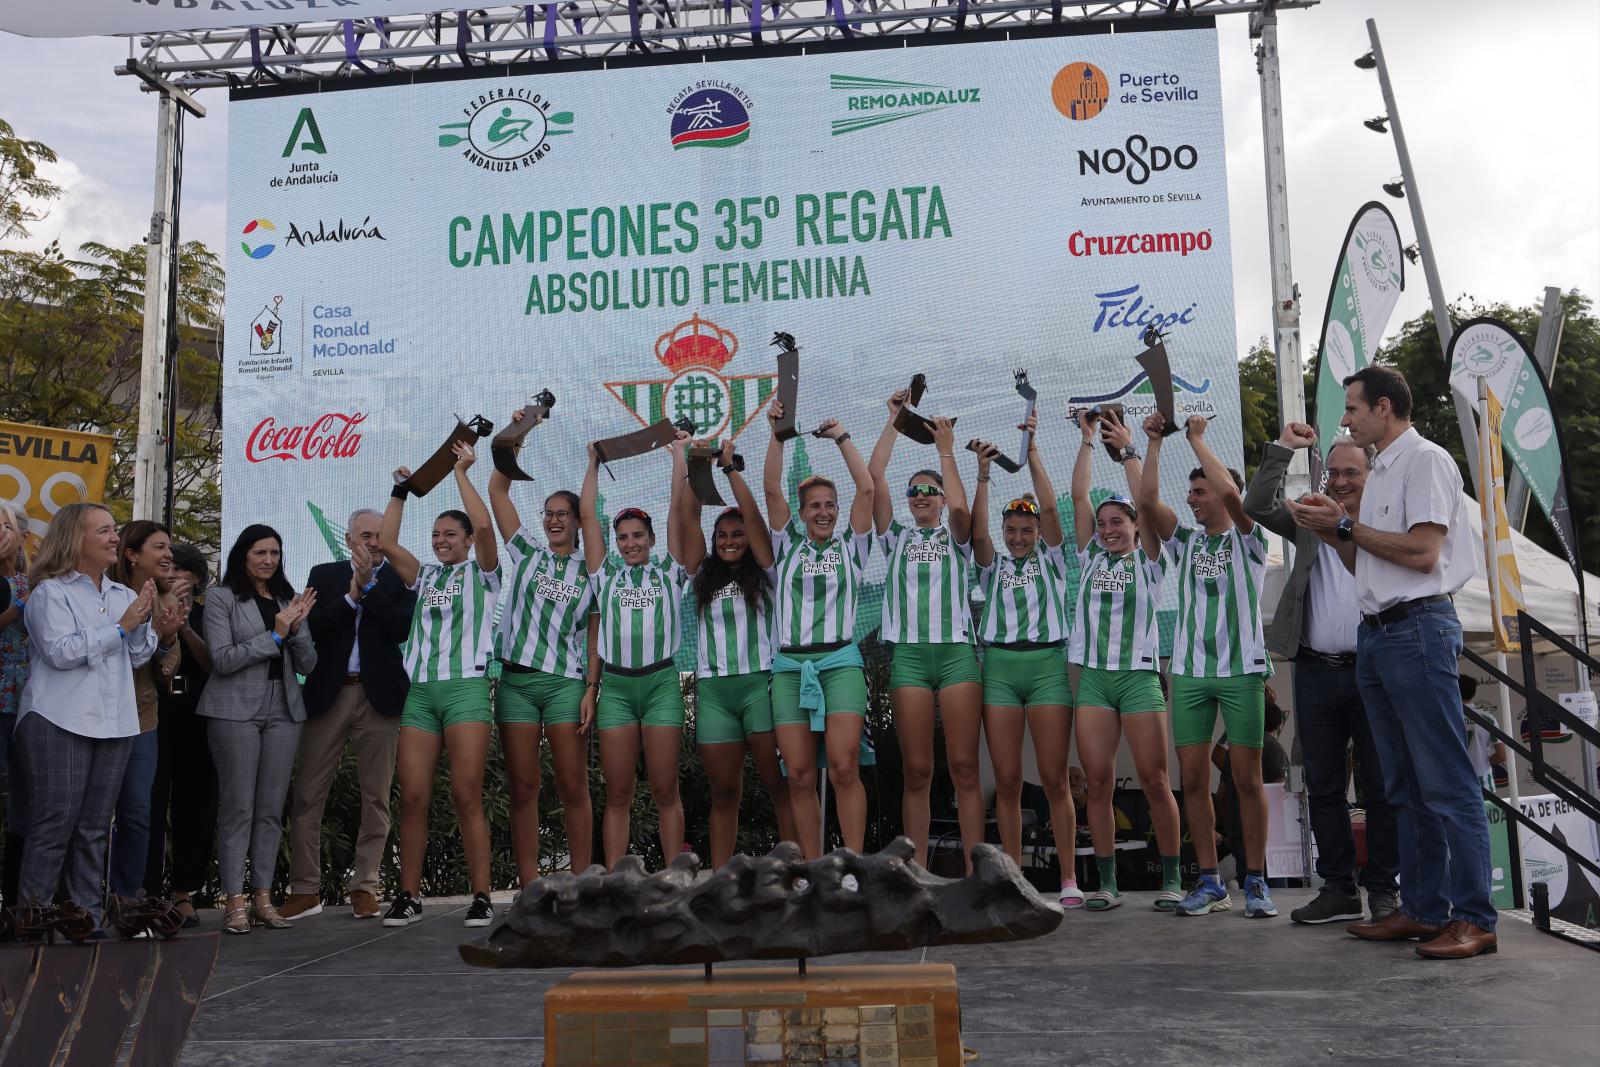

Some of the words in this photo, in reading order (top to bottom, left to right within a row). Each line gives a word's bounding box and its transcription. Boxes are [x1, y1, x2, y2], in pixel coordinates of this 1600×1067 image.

[1120, 72, 1180, 87] Puerto
[463, 88, 551, 116] FEDERACION
[666, 85, 694, 115] REGATA
[695, 79, 754, 109] SEVILLA-BETIS
[848, 87, 981, 110] REMOANDALUZ
[1120, 92, 1137, 103] de
[1141, 86, 1198, 102] Sevilla
[463, 148, 519, 172] ANDALUZA
[522, 143, 551, 168] REMO
[289, 161, 320, 173] Junta
[270, 175, 284, 187] de
[285, 171, 338, 186] Andalucía
[1081, 195, 1150, 207] AYUNTAMIENTO
[1152, 194, 1165, 203] DE
[1167, 192, 1202, 202] SEVILLA
[285, 215, 387, 248] Andalucía
[448, 200, 699, 269] CAMPEONES
[795, 185, 953, 247] REGATA
[1068, 229, 1212, 257] Cruzcampo
[525, 265, 690, 316] ABSOLUTO
[703, 255, 871, 306] FEMENINA
[312, 304, 352, 320] Casa
[1093, 284, 1197, 341] Filippi
[312, 321, 370, 339] Ronald
[312, 339, 395, 358] McDonald
[312, 368, 345, 377] SEVILLA
[1176, 401, 1215, 413] Sevilla
[245, 411, 369, 463] Coca-Cola
[908, 552, 941, 562] GREEN
[534, 571, 580, 597] FOREVER
[1092, 580, 1124, 591] GREEN
[536, 585, 571, 603] GREEN
[620, 597, 655, 607] GREEN
[1538, 801, 1552, 817] DE
[1555, 800, 1576, 816] REM
